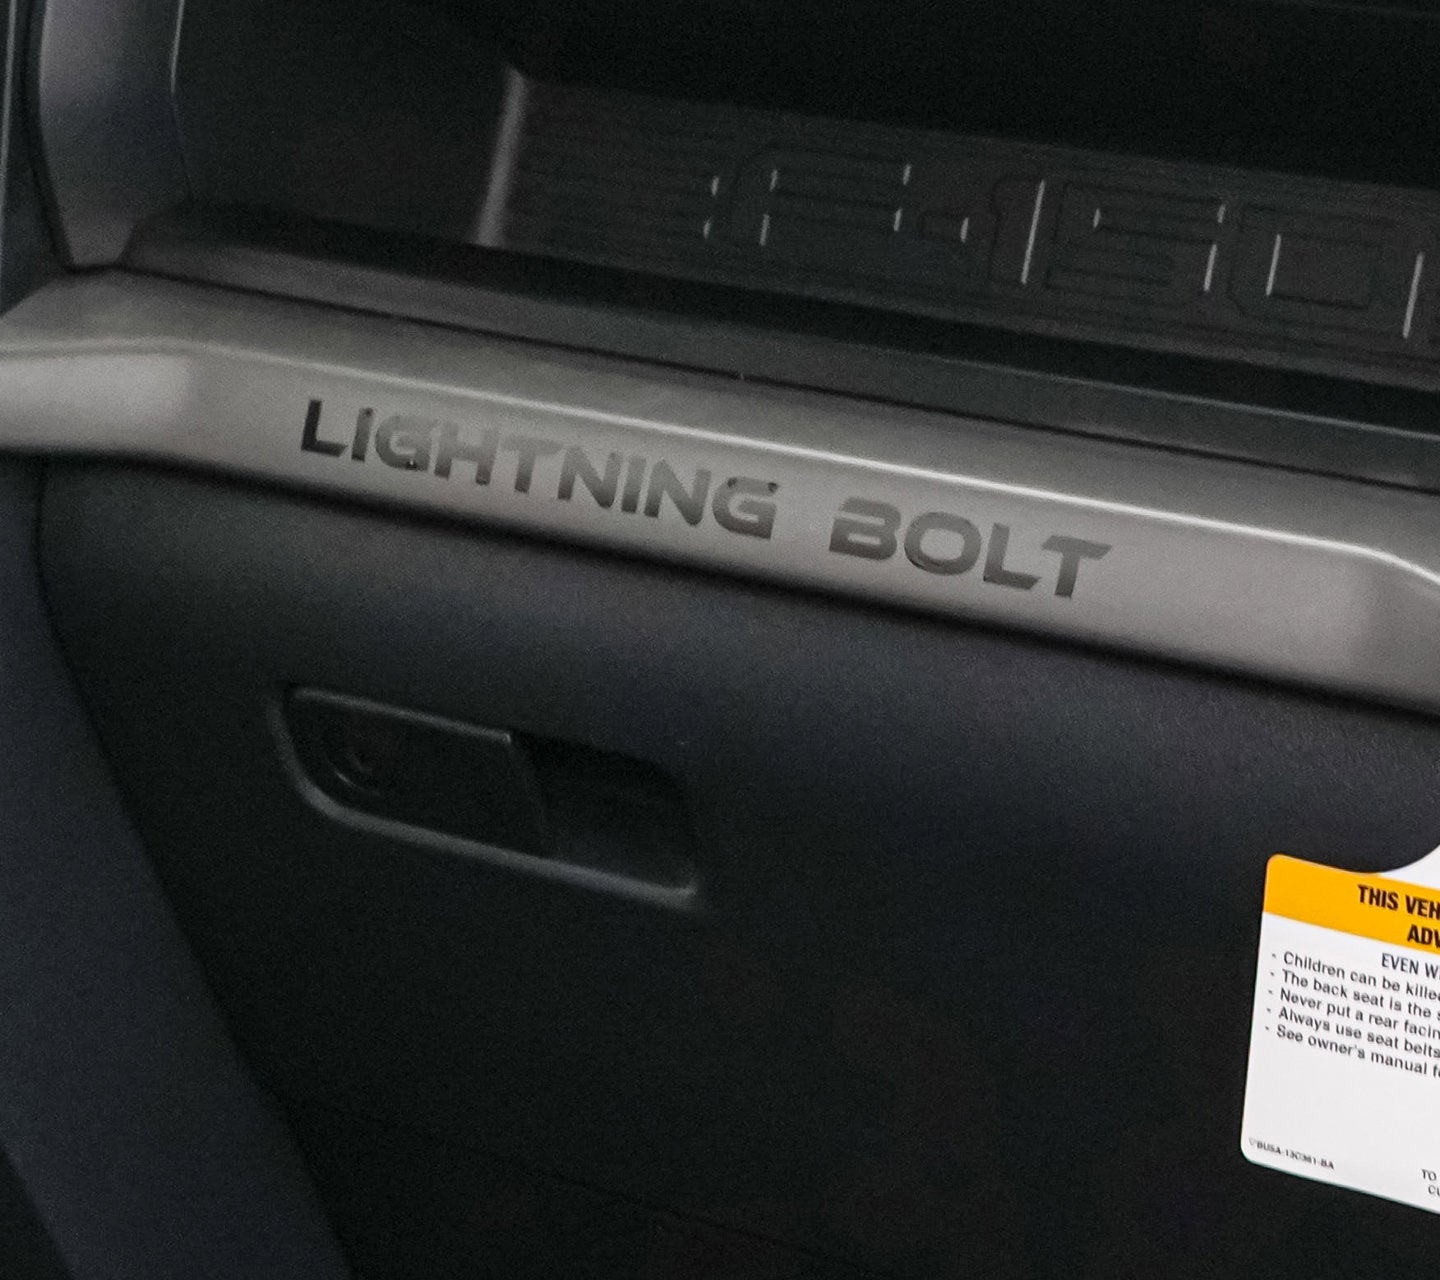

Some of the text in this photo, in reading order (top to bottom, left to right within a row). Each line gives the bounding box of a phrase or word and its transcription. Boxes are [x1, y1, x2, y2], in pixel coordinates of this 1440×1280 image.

[300, 399, 1113, 599] LIGHTNING BOLT
[1357, 884, 1399, 911] THIS
[1283, 950, 1345, 980] Children
[1349, 971, 1377, 987] can
[1382, 975, 1400, 992] be
[1381, 952, 1419, 975] EVEN
[1280, 986, 1322, 1010] Never
[1326, 1002, 1350, 1019] put
[1355, 1010, 1363, 1021] a
[1368, 1013, 1398, 1030] rear
[1282, 968, 1309, 988] The
[1313, 977, 1348, 999] back
[1353, 991, 1384, 1008] seat
[1389, 996, 1402, 1011] is
[1407, 1001, 1432, 1018] the
[1276, 1023, 1303, 1043] See
[1307, 1035, 1365, 1059] owner's
[1370, 1051, 1427, 1075] manual
[1278, 1006, 1330, 1032] Always
[1335, 1024, 1362, 1039] use
[1367, 1032, 1399, 1050] seat
[1403, 1037, 1440, 1059] belts
[1421, 1168, 1437, 1181] TO
